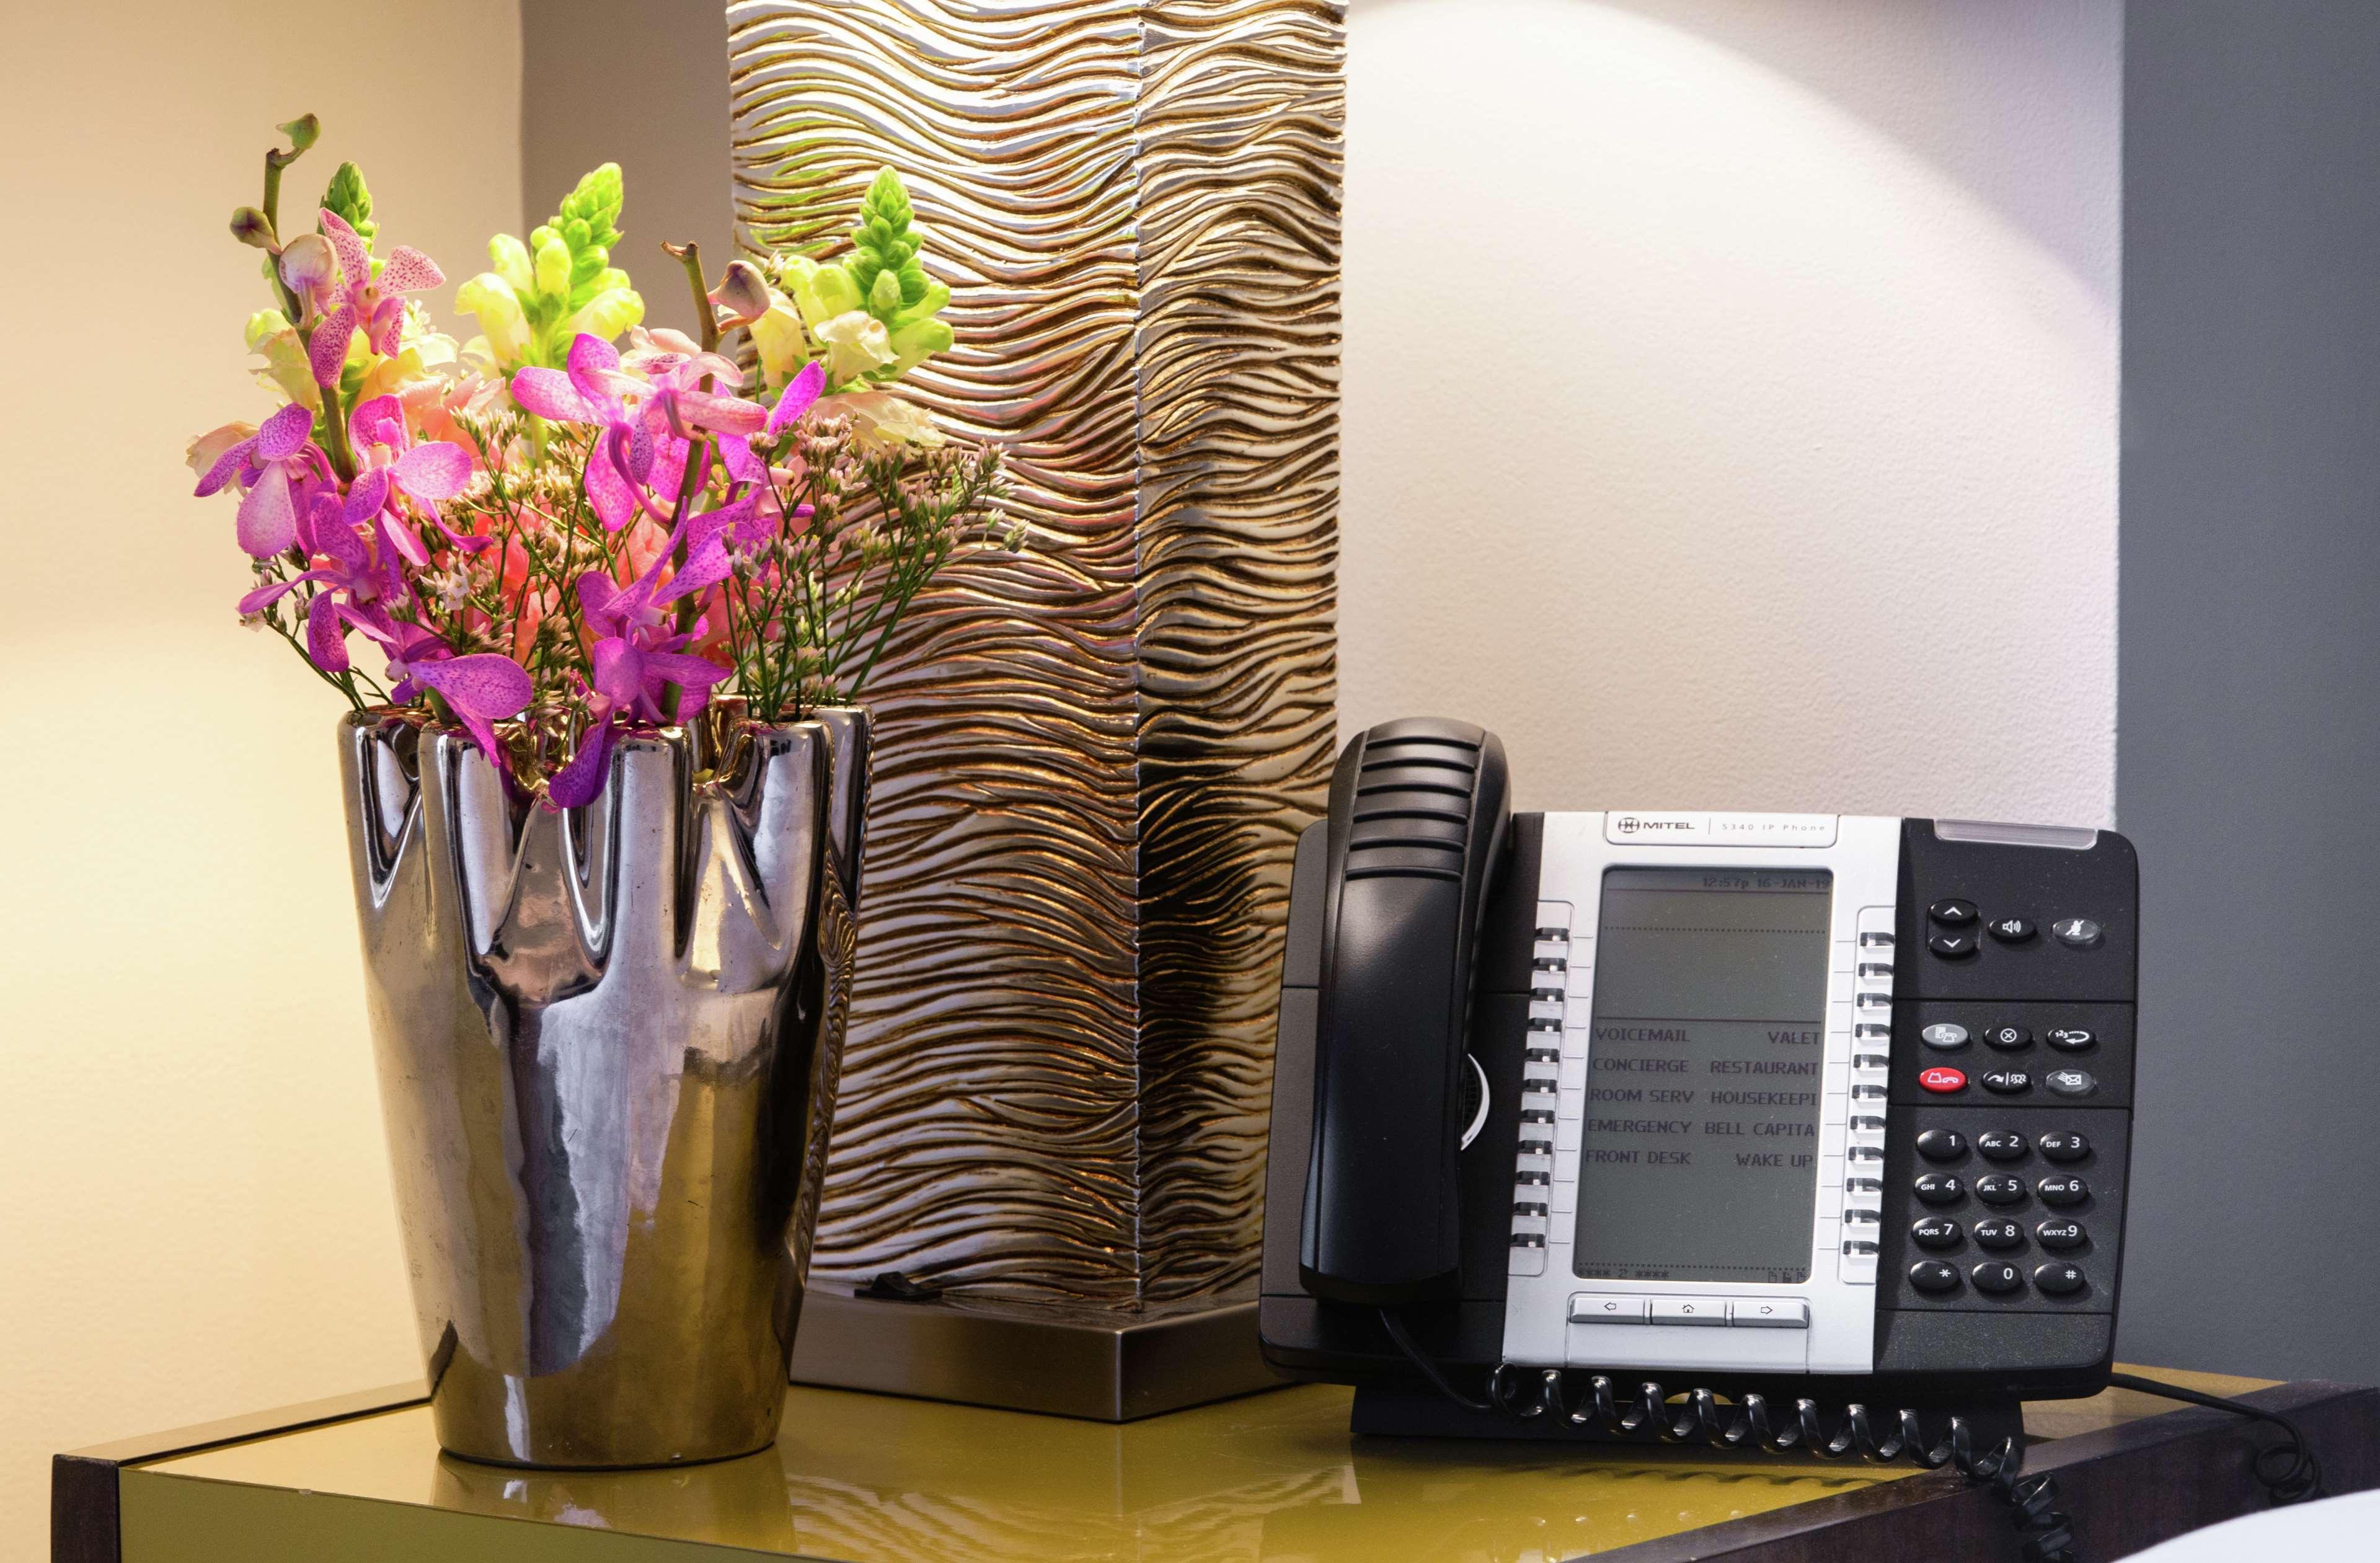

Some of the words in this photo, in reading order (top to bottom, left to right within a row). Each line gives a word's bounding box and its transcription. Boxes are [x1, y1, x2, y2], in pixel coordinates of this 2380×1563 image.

[1783, 824, 1826, 832] Phone
[1596, 1027, 1691, 1043] VOICEMAIL
[1767, 1030, 1820, 1045] VALET
[1592, 1058, 1689, 1074] CONCIERGE
[1710, 1060, 1818, 1076] RESTAURANT
[1590, 1088, 1642, 1103] ROOM
[1650, 1090, 1694, 1104] SERV
[1710, 1091, 1817, 1106] HOUSEKEEPI
[1587, 1118, 1692, 1135] EMERGENCY
[1704, 1122, 1745, 1135] BELL
[1753, 1122, 1815, 1136] CAPITA
[1949, 1135, 1956, 1146] 1
[2009, 1135, 2019, 1147] 2
[2071, 1136, 2081, 1148] 3
[1585, 1149, 1640, 1164] FRONT
[1647, 1151, 1692, 1165] DESK
[1736, 1153, 1783, 1167] WAKE
[1790, 1154, 1813, 1168] UP
[1945, 1179, 1955, 1191] 4
[2008, 1180, 2017, 1192] 5
[2069, 1180, 2079, 1192] 6
[1944, 1224, 1953, 1235] 7
[2005, 1224, 2015, 1236] 8
[2068, 1225, 2077, 1237] 9
[2003, 1268, 2013, 1280] 0
[2065, 1270, 2076, 1279] #
